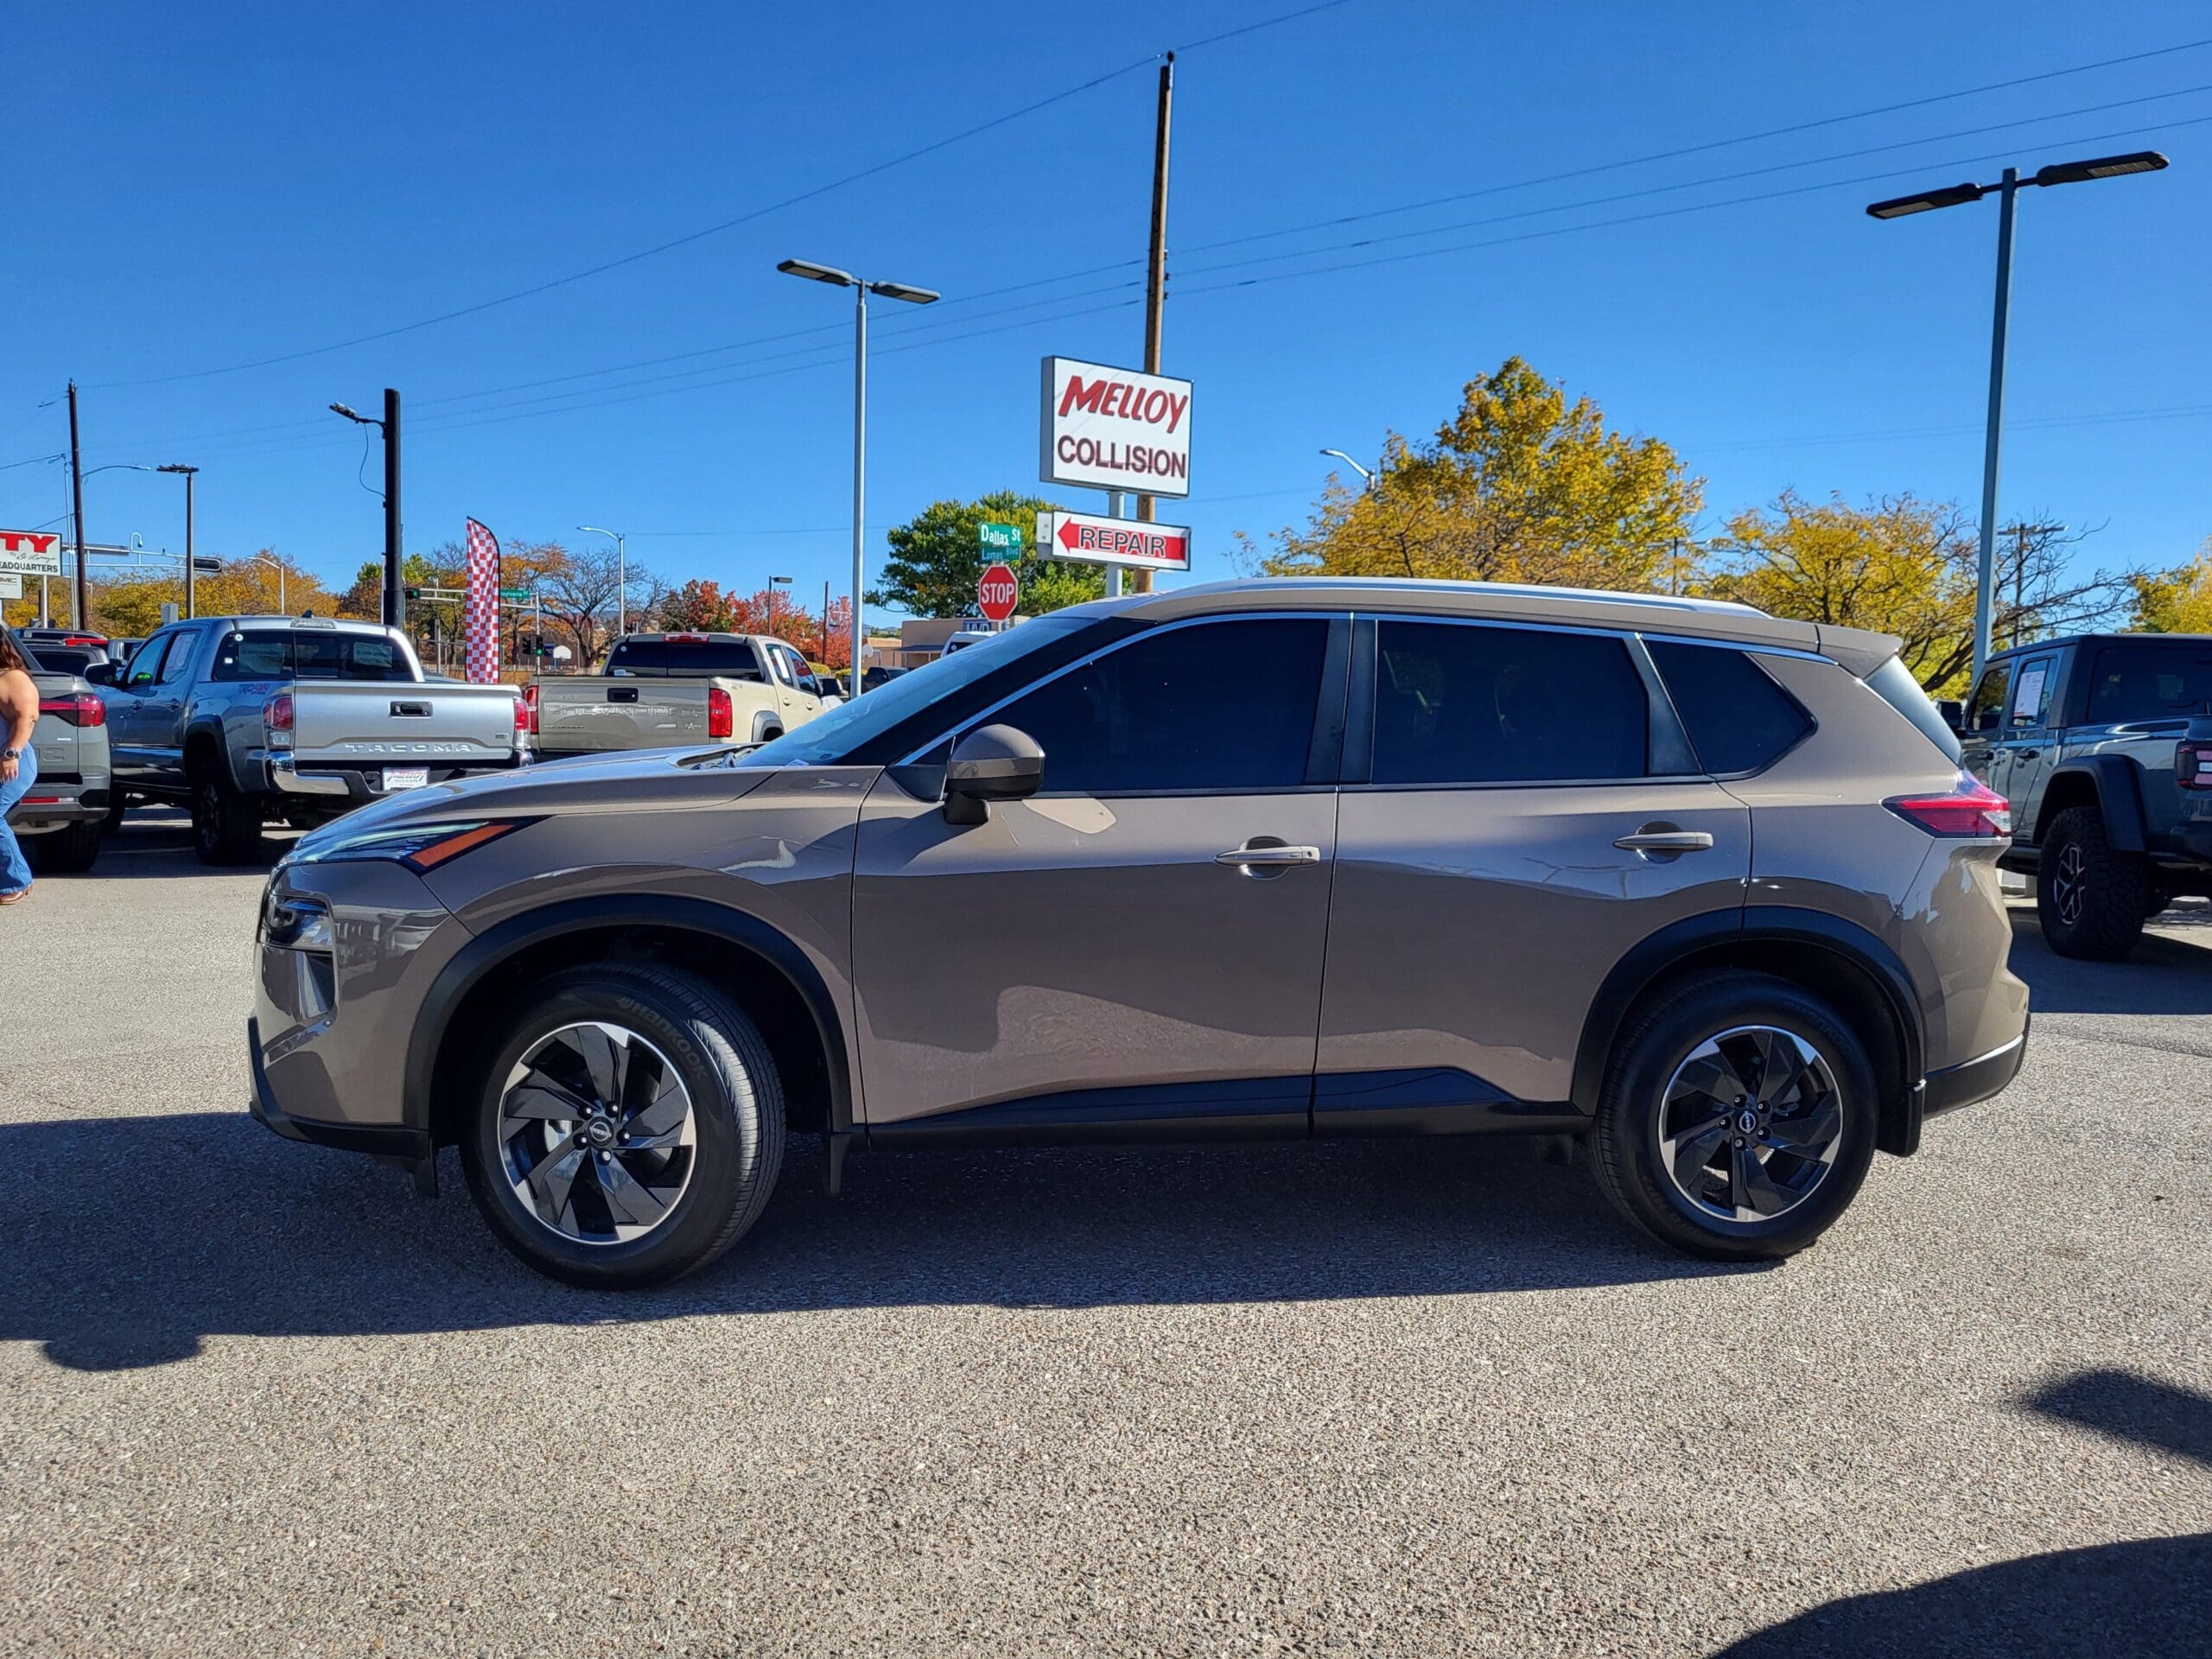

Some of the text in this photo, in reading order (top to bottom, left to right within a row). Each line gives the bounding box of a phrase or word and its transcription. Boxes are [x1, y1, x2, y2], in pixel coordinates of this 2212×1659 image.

[1058, 375, 1189, 434] MELLOY
[1057, 435, 1186, 479] COLLISION
[981, 524, 1021, 546] Dallas St
[1080, 527, 1166, 556] REPAIR
[982, 546, 1019, 561] Lomas Blvd
[981, 582, 1015, 604] STOP
[346, 743, 473, 753] TACOMA
